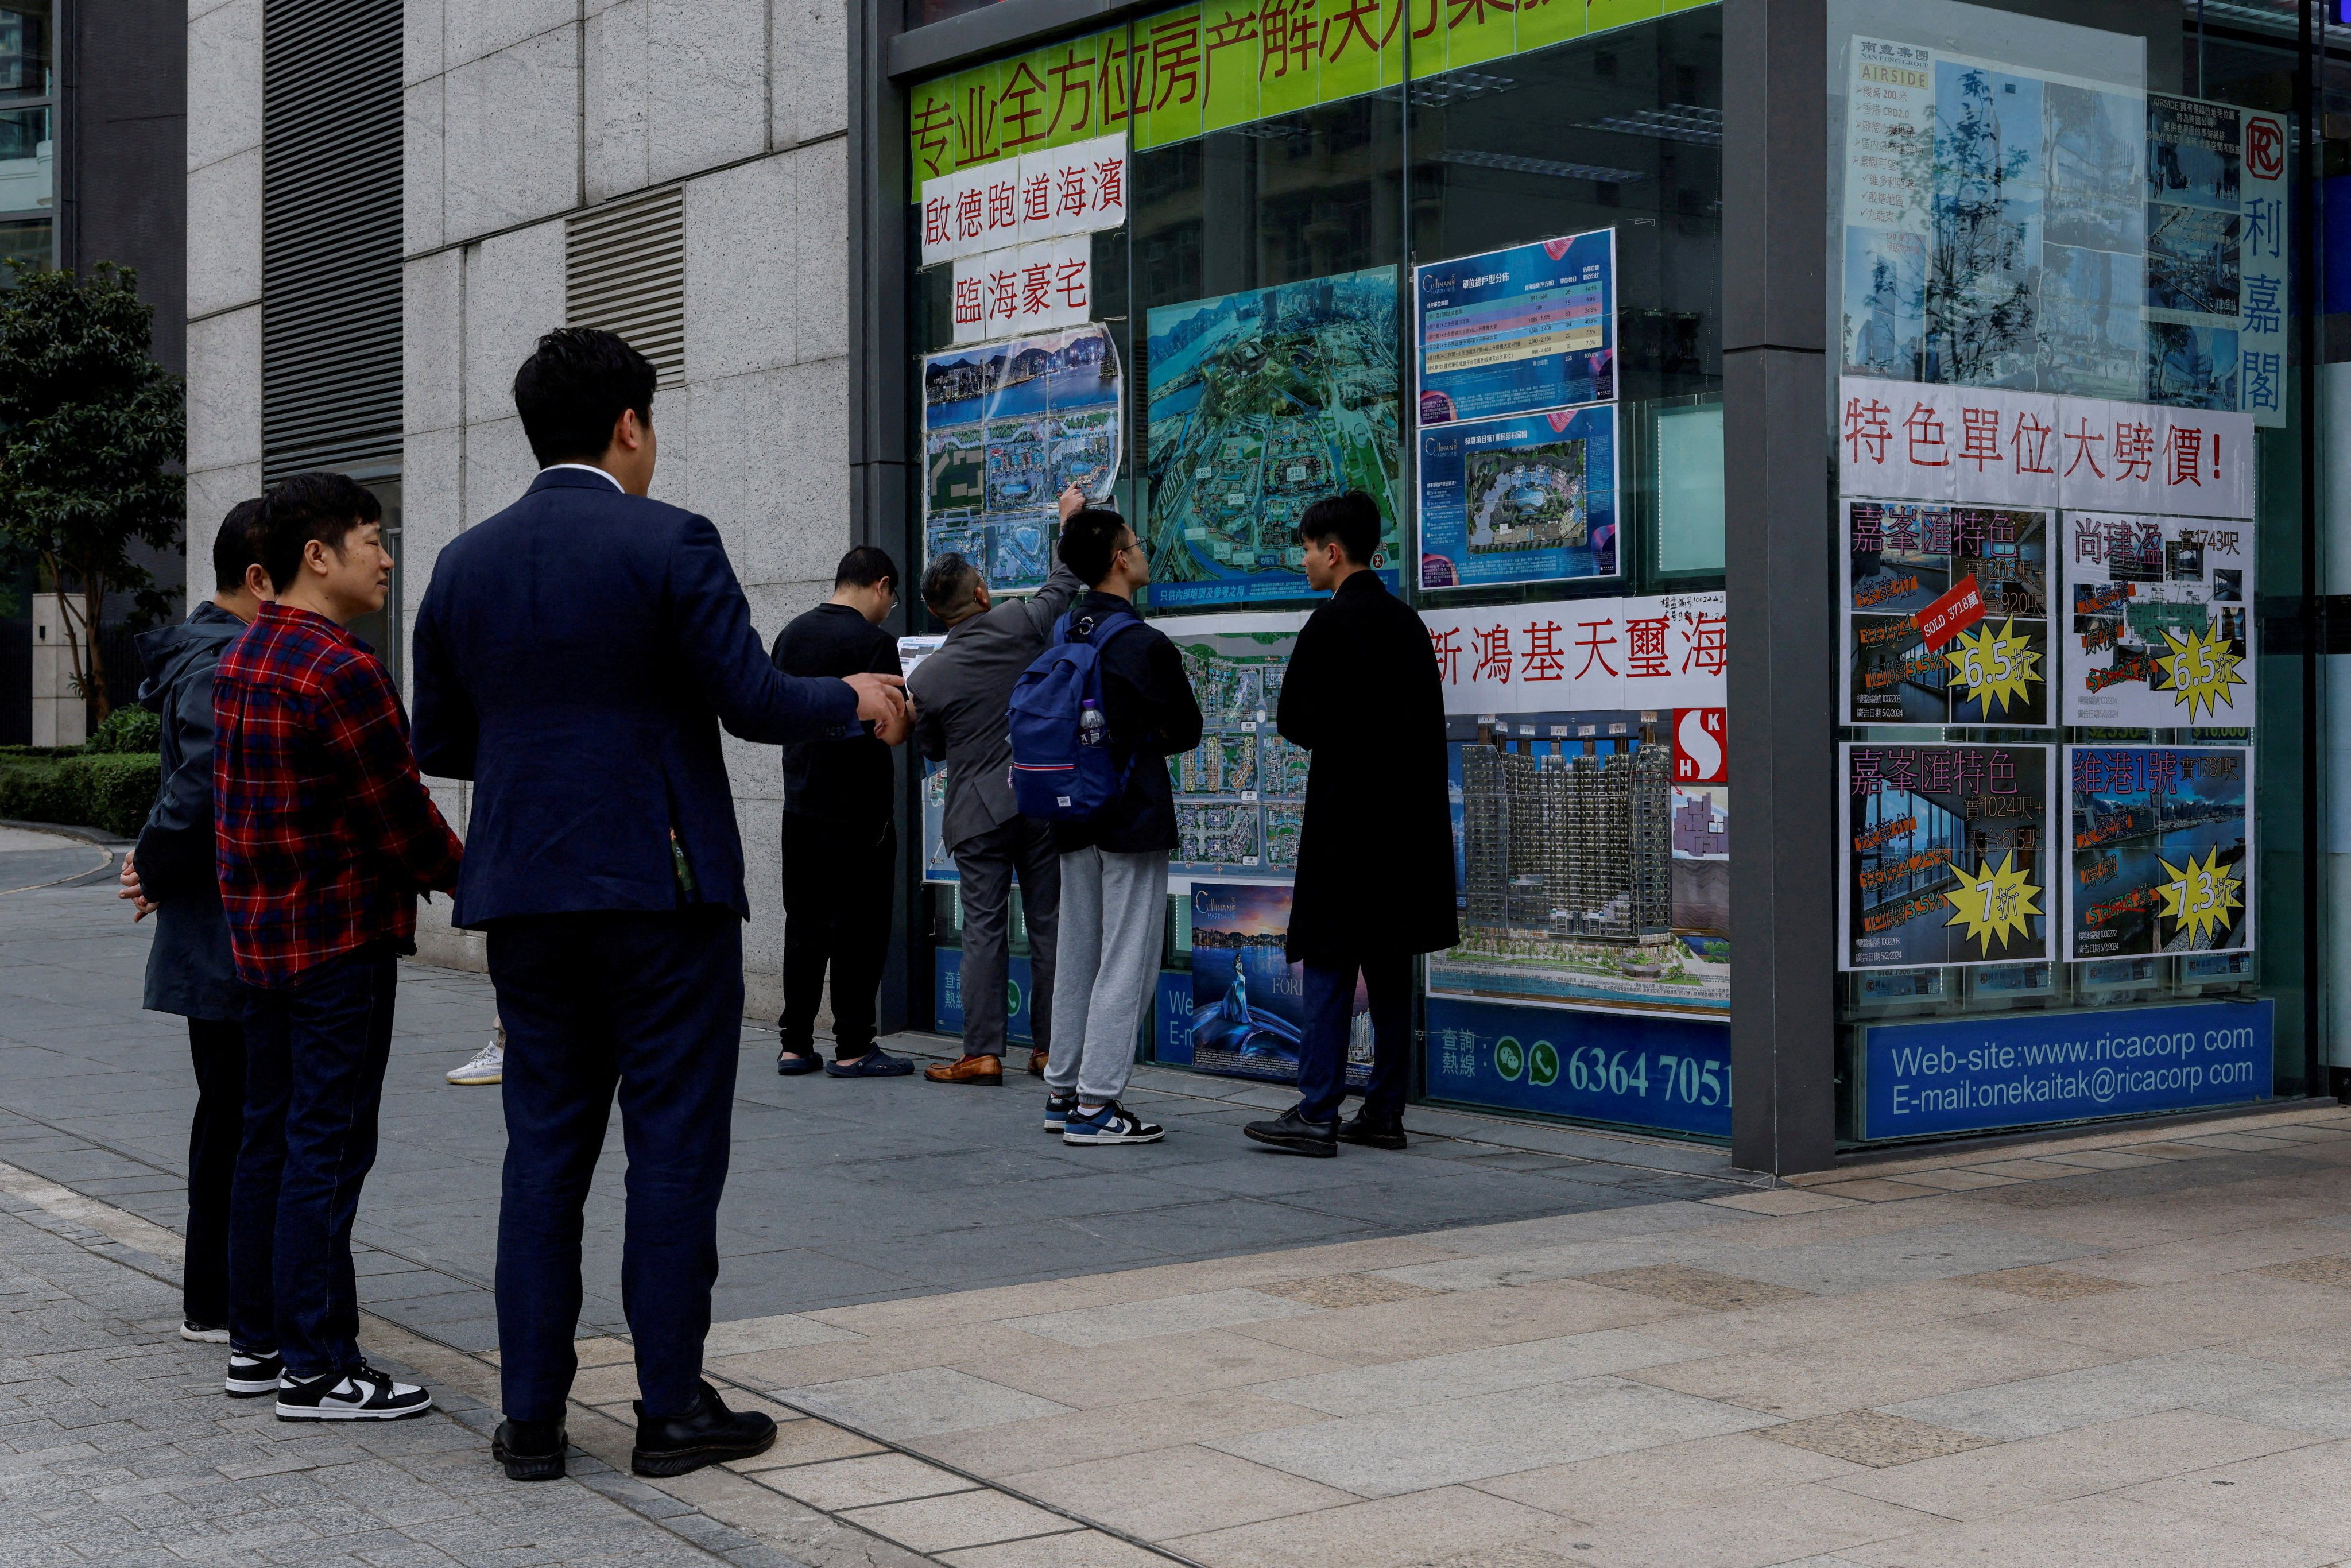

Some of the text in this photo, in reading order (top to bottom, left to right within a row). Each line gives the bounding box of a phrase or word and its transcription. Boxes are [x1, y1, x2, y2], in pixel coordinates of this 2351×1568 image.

[1861, 53, 1929, 68] NAN FUNG GROUP
[1862, 64, 1926, 87] AIRSIDE
[1863, 102, 1881, 117] 香港
[1883, 90, 1897, 100] 200
[2154, 99, 2179, 110] AIRSIDE
[924, 157, 1124, 247] 啟德跑道海濱
[956, 258, 1087, 324] 臨海豪宅
[2242, 196, 2282, 412] 利嘉閣
[1845, 396, 2221, 487] 特色單位大劈價!
[1851, 506, 2018, 557] 嘉峯匯特色
[1923, 613, 1947, 638] SOLD
[1964, 640, 2034, 688] 6.5折
[2173, 644, 2236, 691] 6.5折
[1851, 748, 2018, 797] 嘉峯匯特色
[2073, 751, 2177, 795] 維港1號
[1976, 880, 2019, 922] 7折
[2171, 871, 2236, 919] 7.3折
[1569, 1046, 1649, 1097] 6364
[1892, 1025, 2254, 1077] Web-site:www.ricacorp com
[1893, 1059, 2253, 1115] E-mail:onekaitak@ricacorp com
